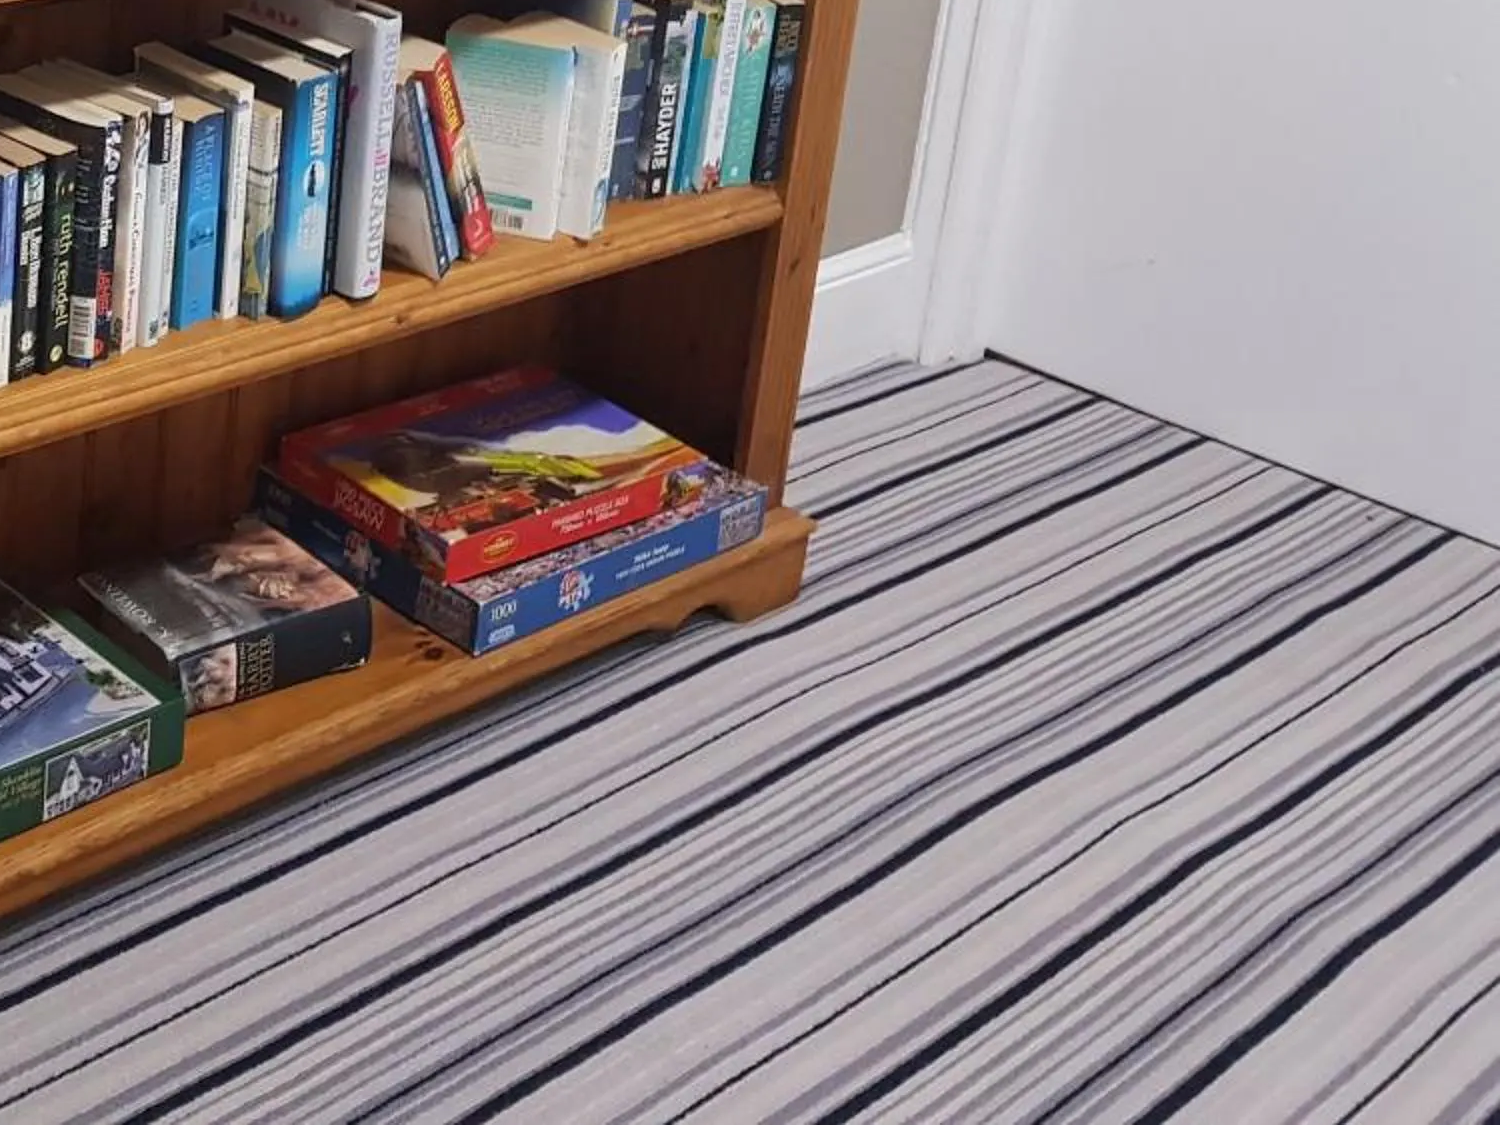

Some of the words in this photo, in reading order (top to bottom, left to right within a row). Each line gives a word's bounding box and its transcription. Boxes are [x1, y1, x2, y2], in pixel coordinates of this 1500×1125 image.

[372, 31, 398, 151] RUSSELL
[654, 82, 678, 161] HAYDER
[60, 213, 73, 256] ruth
[366, 168, 388, 263] BRAND
[55, 261, 70, 329] rendell
[491, 598, 517, 621] 1000
